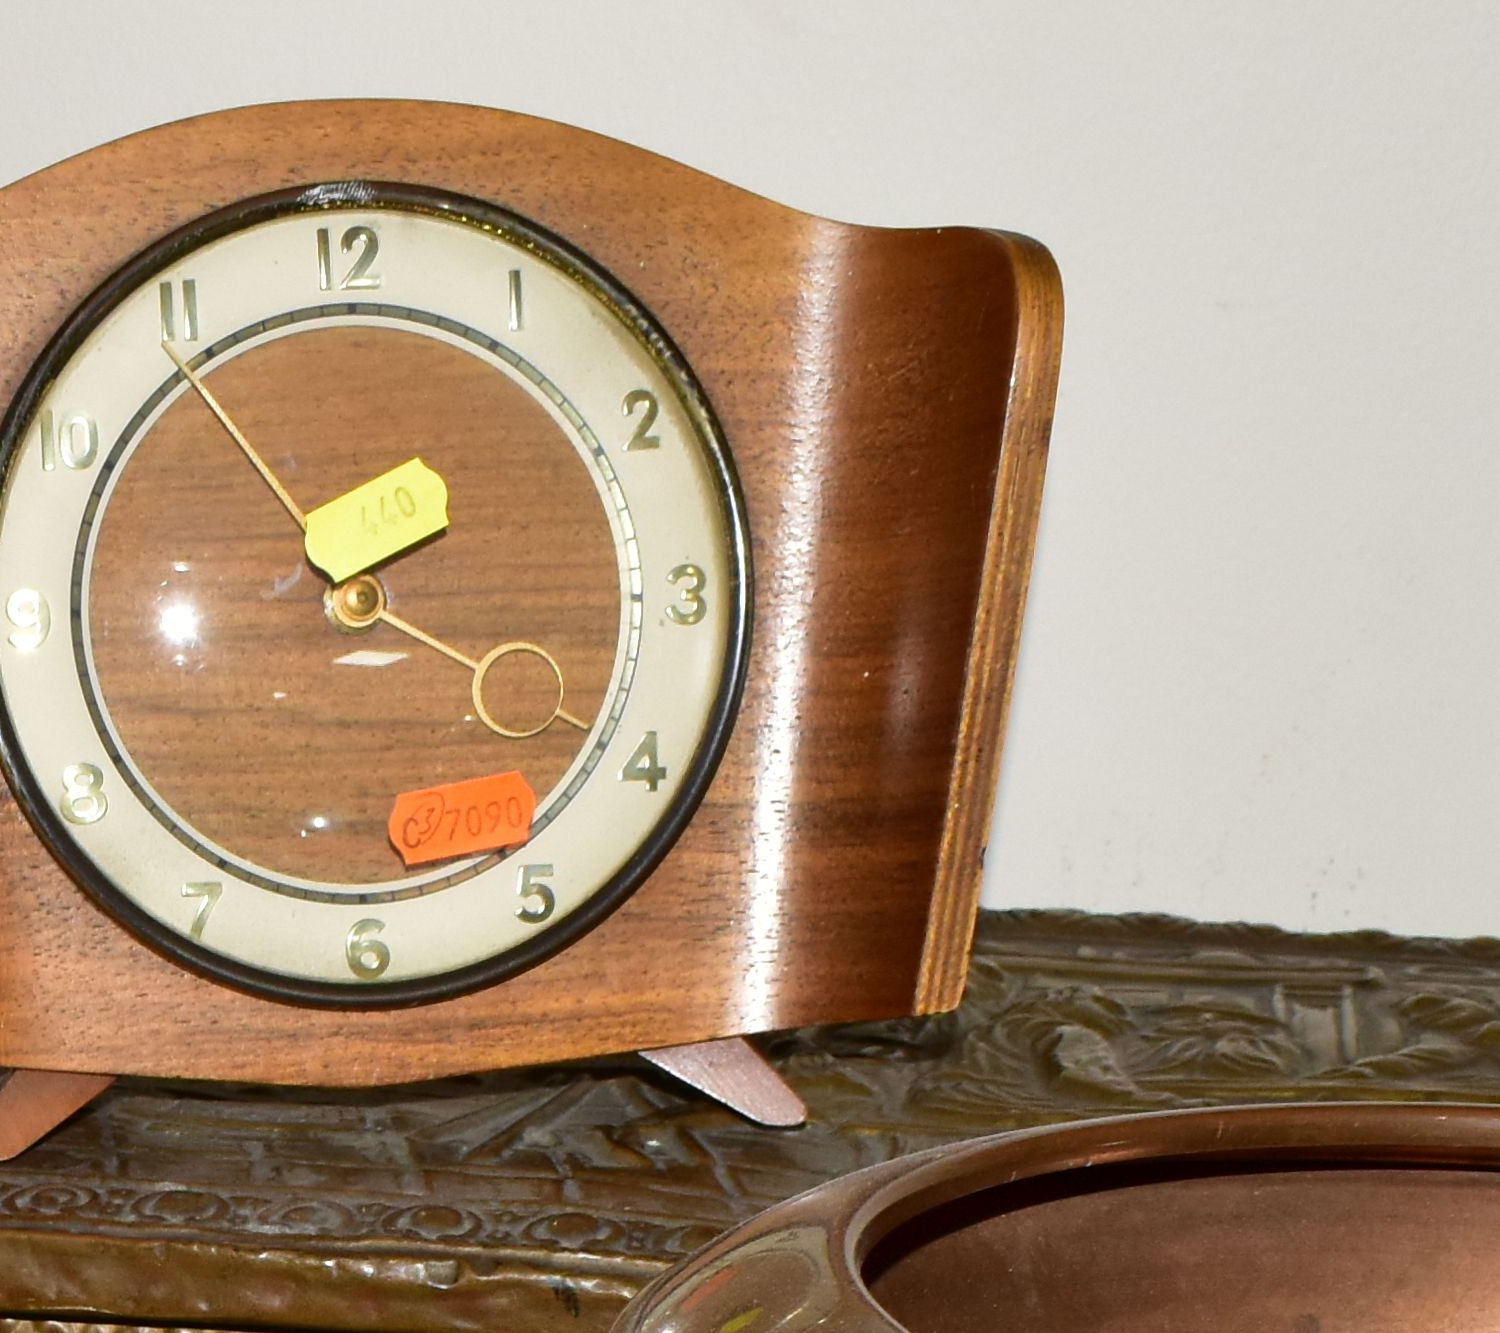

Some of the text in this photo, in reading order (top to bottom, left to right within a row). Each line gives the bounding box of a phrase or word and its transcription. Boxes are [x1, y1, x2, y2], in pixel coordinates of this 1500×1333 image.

[316, 225, 382, 290] 12
[158, 278, 199, 342] 11
[507, 269, 524, 332] 1
[40, 410, 99, 472] 10
[622, 389, 662, 451] 2
[5, 588, 52, 652] 9
[665, 564, 707, 626] 3
[59, 761, 109, 824] 8
[621, 731, 667, 793] 4
[444, 796, 523, 841] 7090
[180, 881, 224, 940] 7
[515, 864, 555, 925] 5
[344, 918, 391, 981] 6
